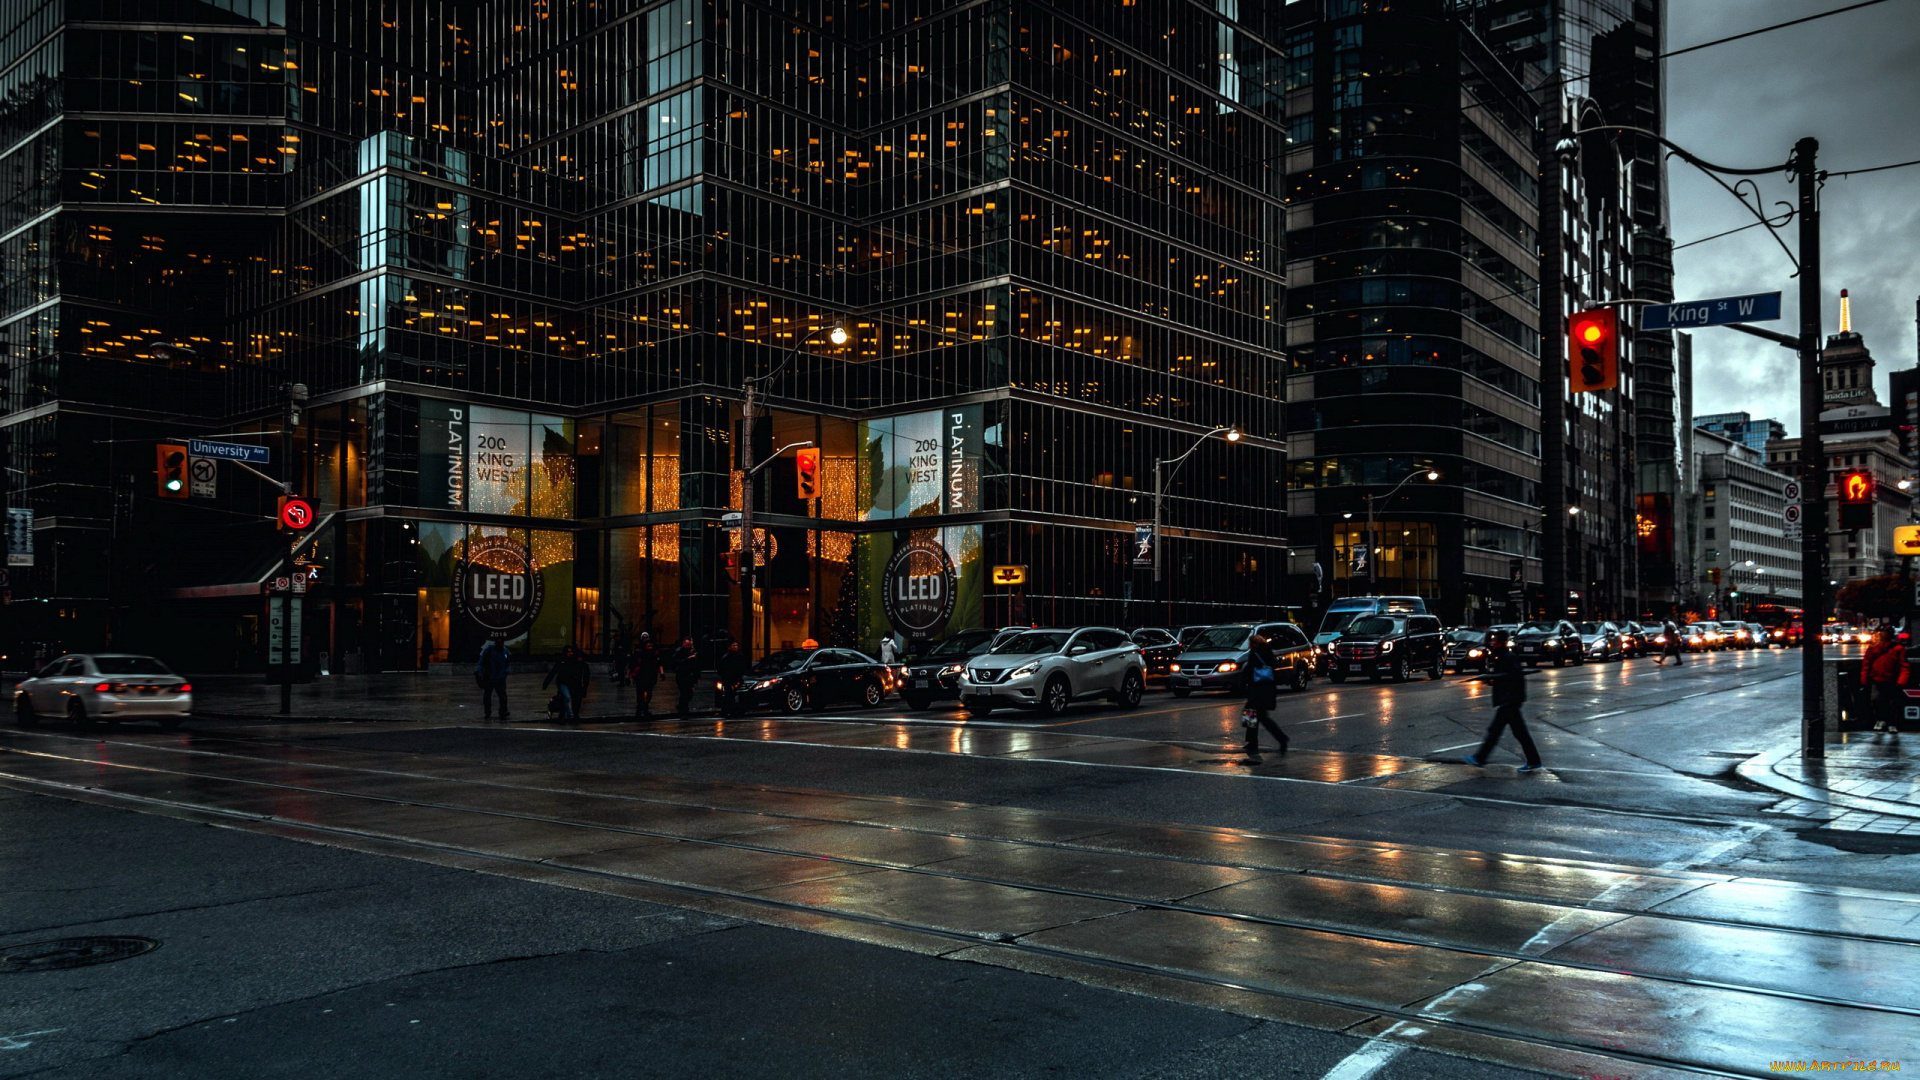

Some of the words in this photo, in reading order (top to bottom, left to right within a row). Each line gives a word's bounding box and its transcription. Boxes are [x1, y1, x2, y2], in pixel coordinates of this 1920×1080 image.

[1667, 305, 1709, 324] King
[1718, 301, 1727, 310] St
[1738, 298, 1755, 316] W
[1823, 391, 1849, 400] anada
[1850, 390, 1867, 398] Life
[1834, 421, 1857, 431] King
[1870, 419, 1878, 427] W
[193, 441, 250, 459] University
[478, 435, 506, 450] 200
[915, 438, 937, 452] 200
[448, 408, 462, 505] PLATINUM
[477, 451, 513, 467] KING
[910, 454, 937, 468] KING
[951, 413, 964, 508] PLATINUM
[477, 467, 518, 483] WEST
[905, 469, 938, 483] WEST
[454, 568, 465, 619] EADERSHIP
[473, 573, 525, 600] LEED
[899, 575, 940, 600] LEED
[883, 572, 893, 619] EADERSHIP
[944, 591, 954, 618] DESIGN
[476, 603, 522, 613] PLATINUM
[900, 604, 938, 613] PLATINUM
